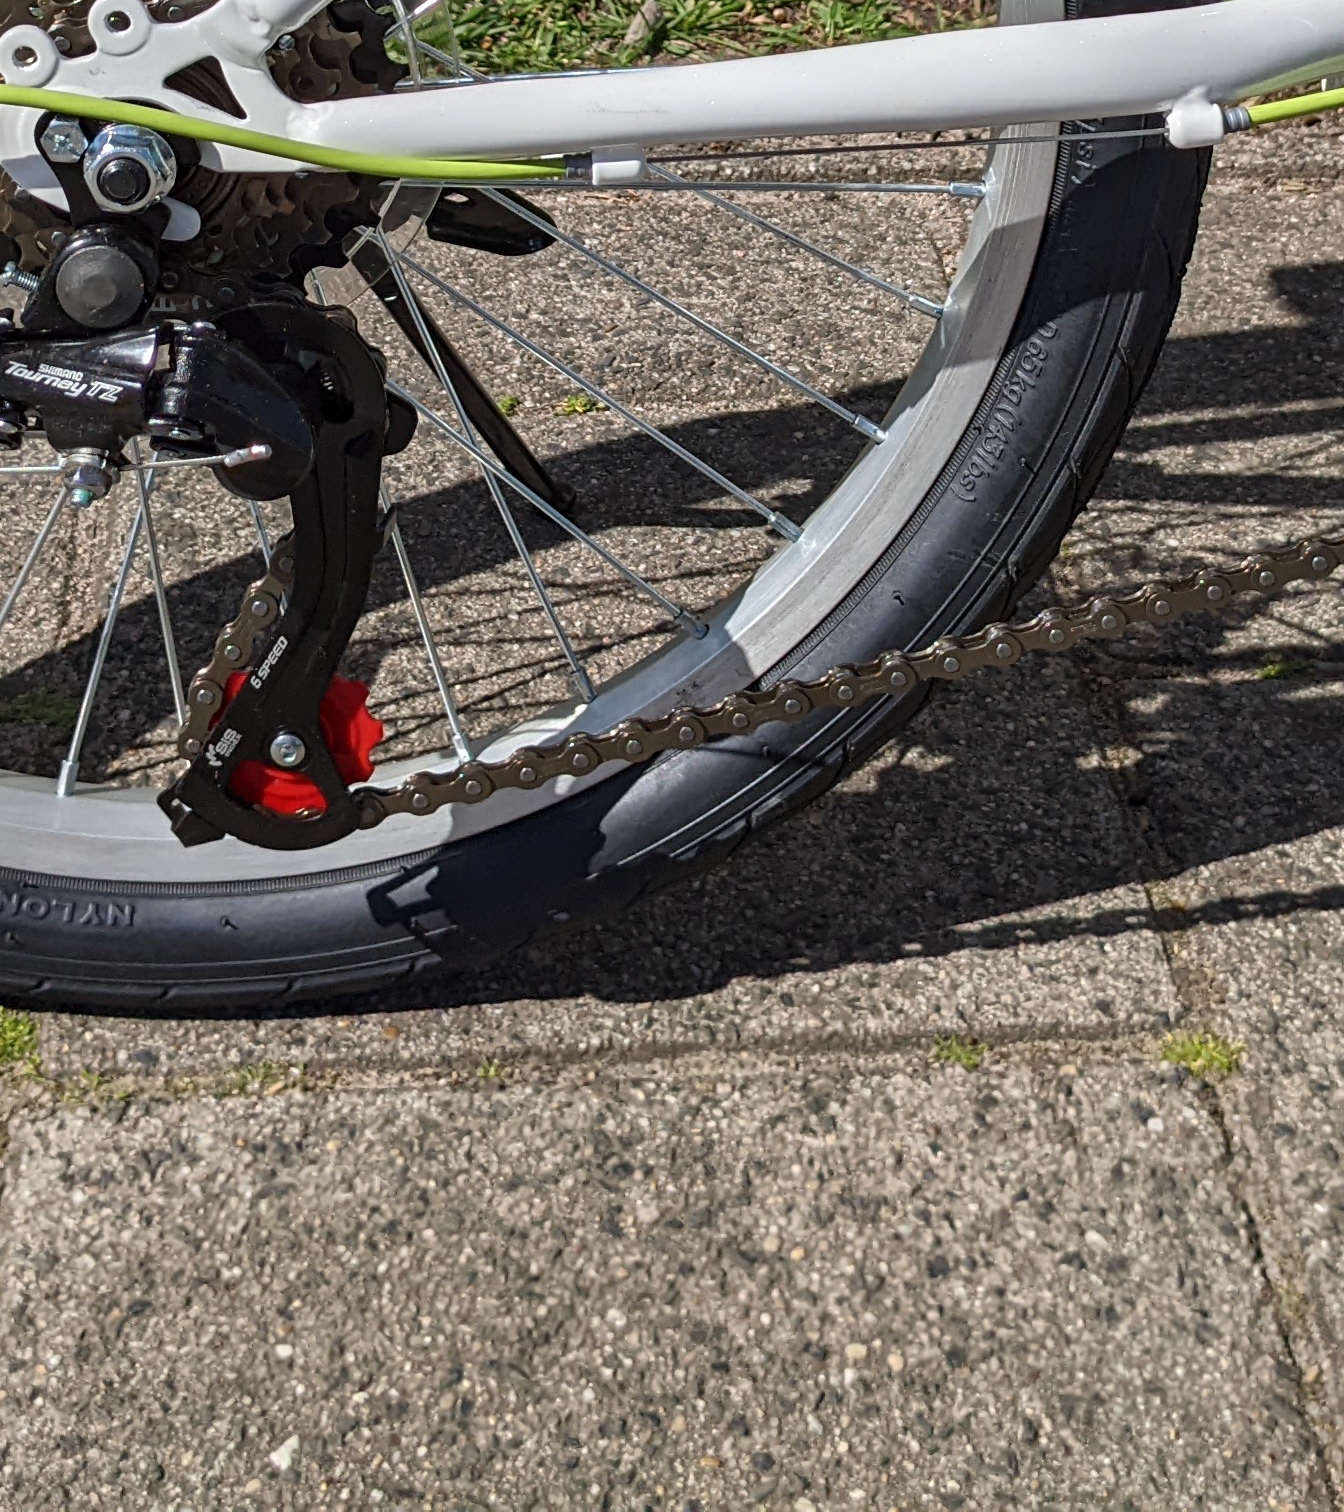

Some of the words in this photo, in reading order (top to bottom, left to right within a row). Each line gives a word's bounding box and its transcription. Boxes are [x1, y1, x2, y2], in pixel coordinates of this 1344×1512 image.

[4, 360, 88, 397] Tourney
[86, 380, 124, 403] TZ
[37, 363, 84, 381] SHIMANO
[249, 674, 263, 690] 6
[258, 635, 289, 682] SPEED
[215, 727, 238, 758] SIS
